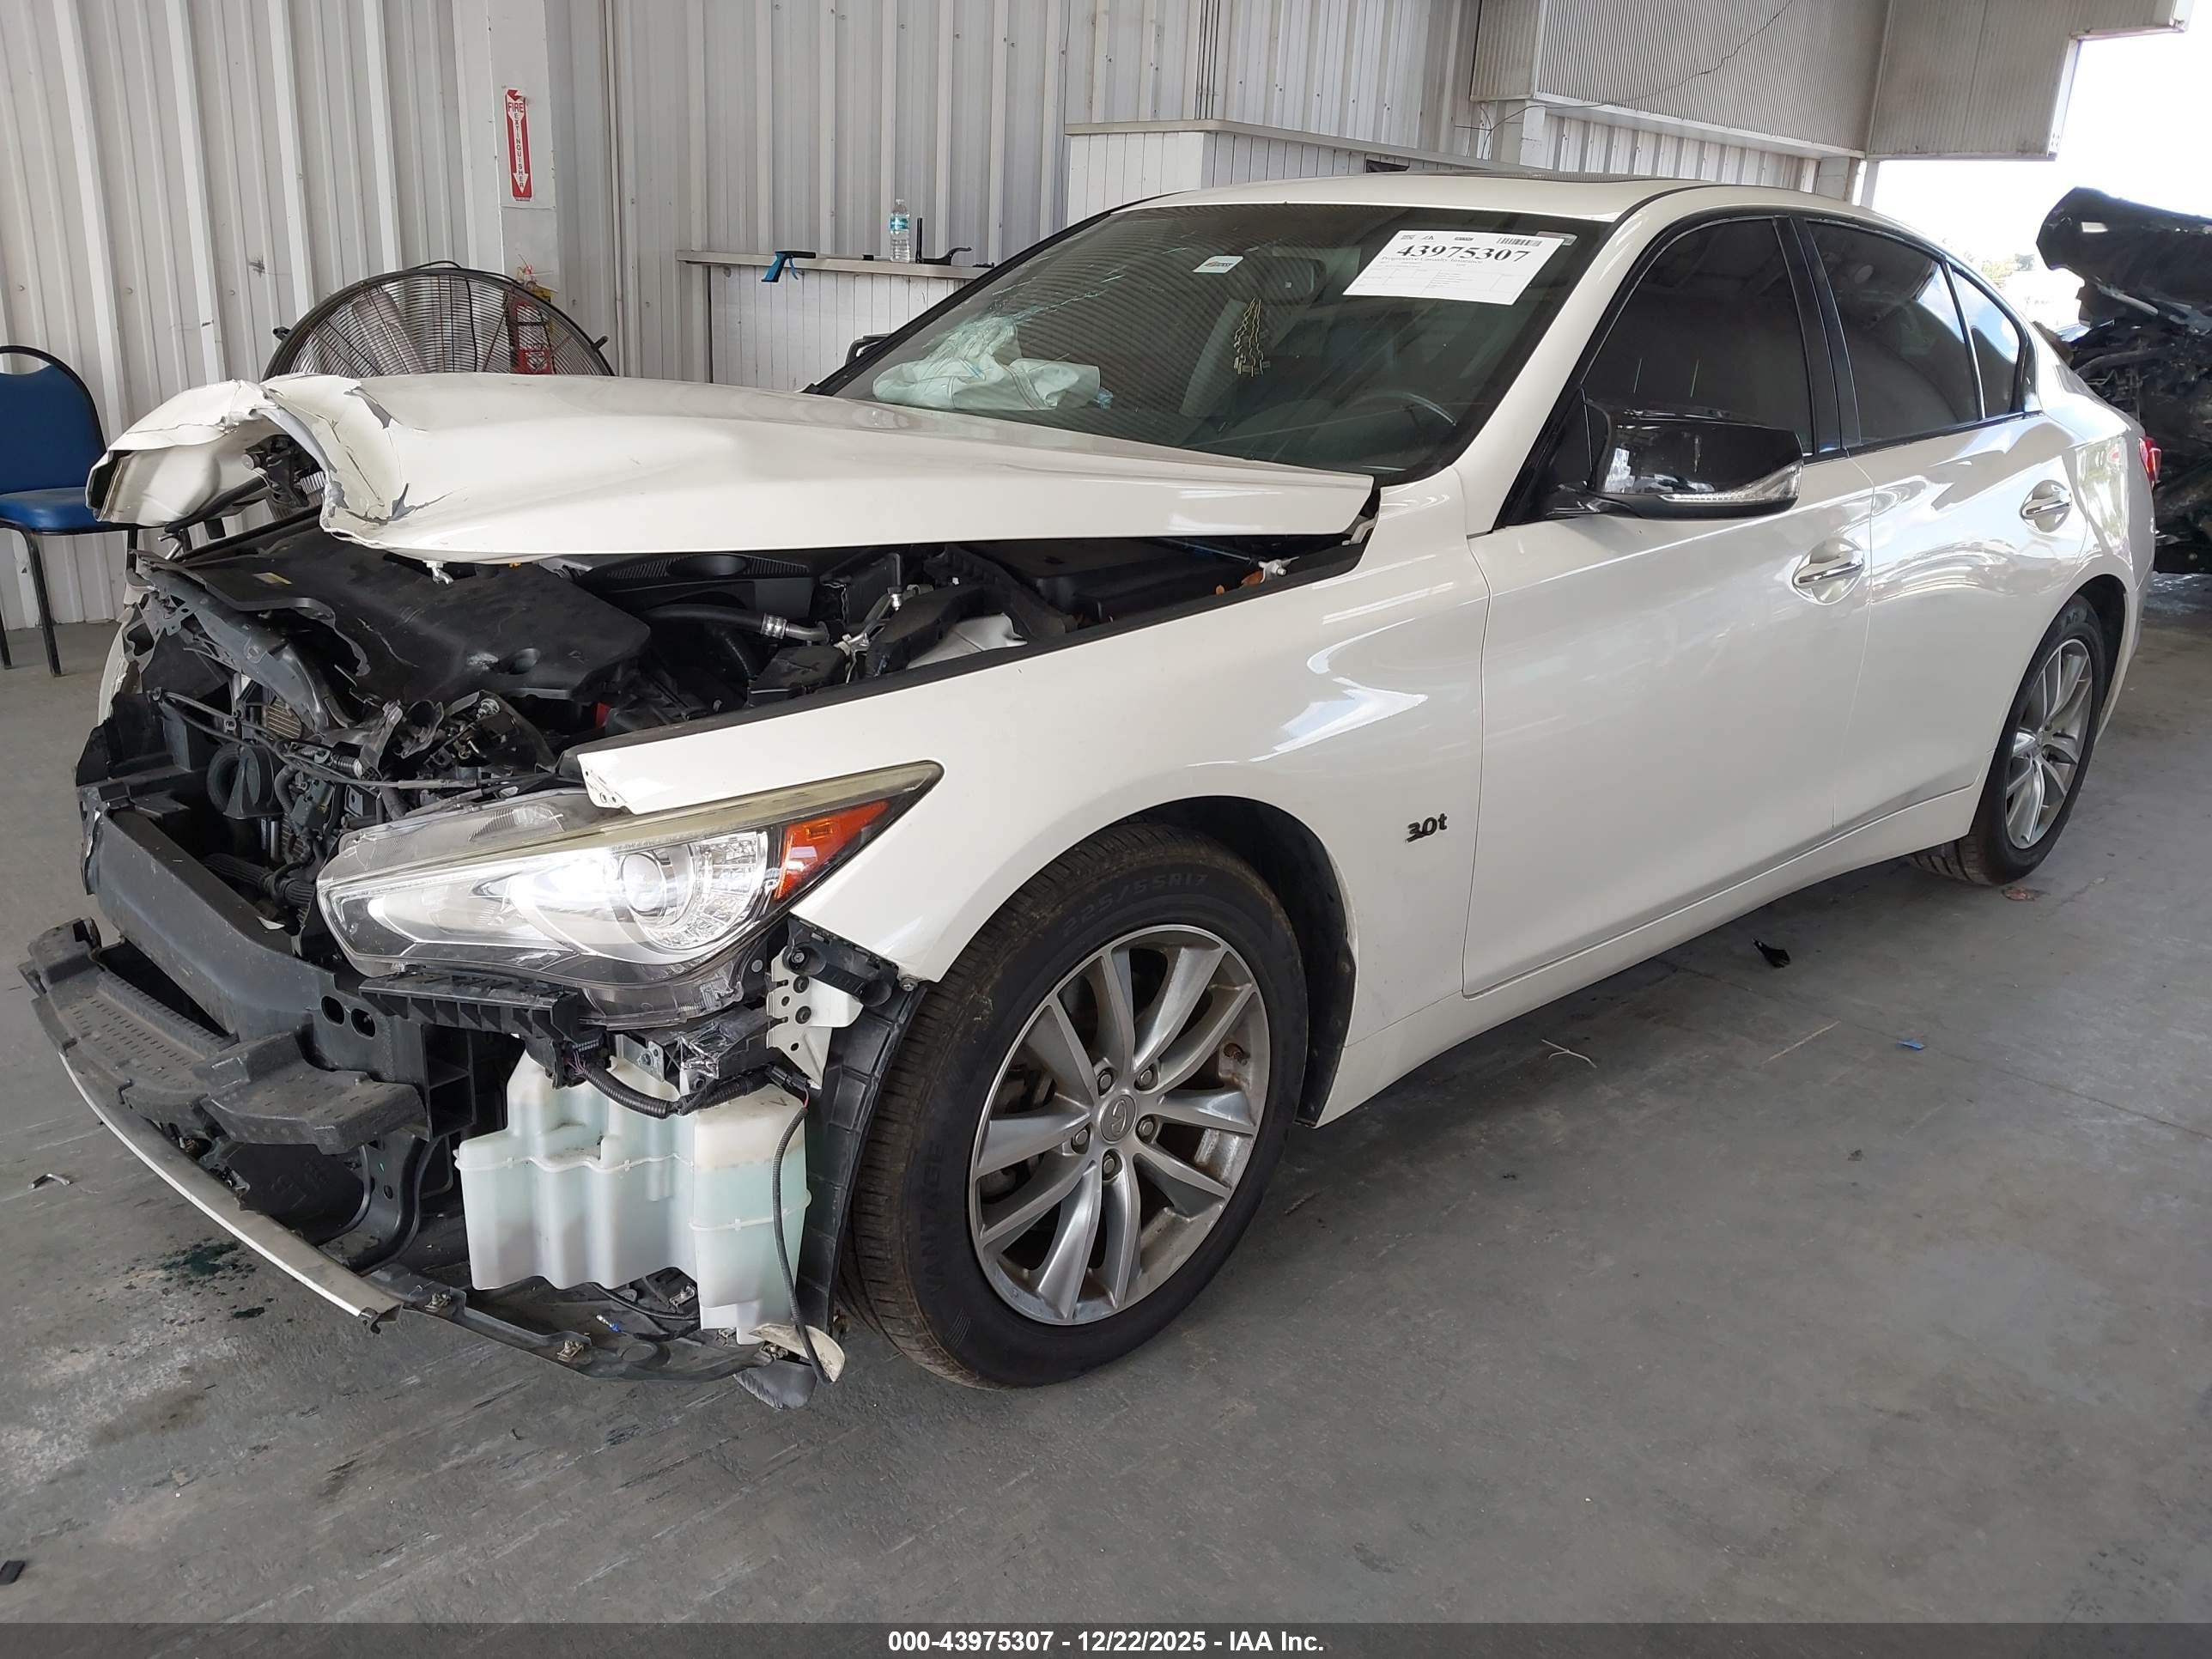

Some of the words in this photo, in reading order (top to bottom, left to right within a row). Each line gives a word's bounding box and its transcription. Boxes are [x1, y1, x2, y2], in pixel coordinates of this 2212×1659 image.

[507, 102, 524, 113] FIRE
[514, 113, 525, 188] EXTINGUISHER
[1396, 244, 1532, 263] 43975307
[1062, 872, 1210, 938] 225/55R17
